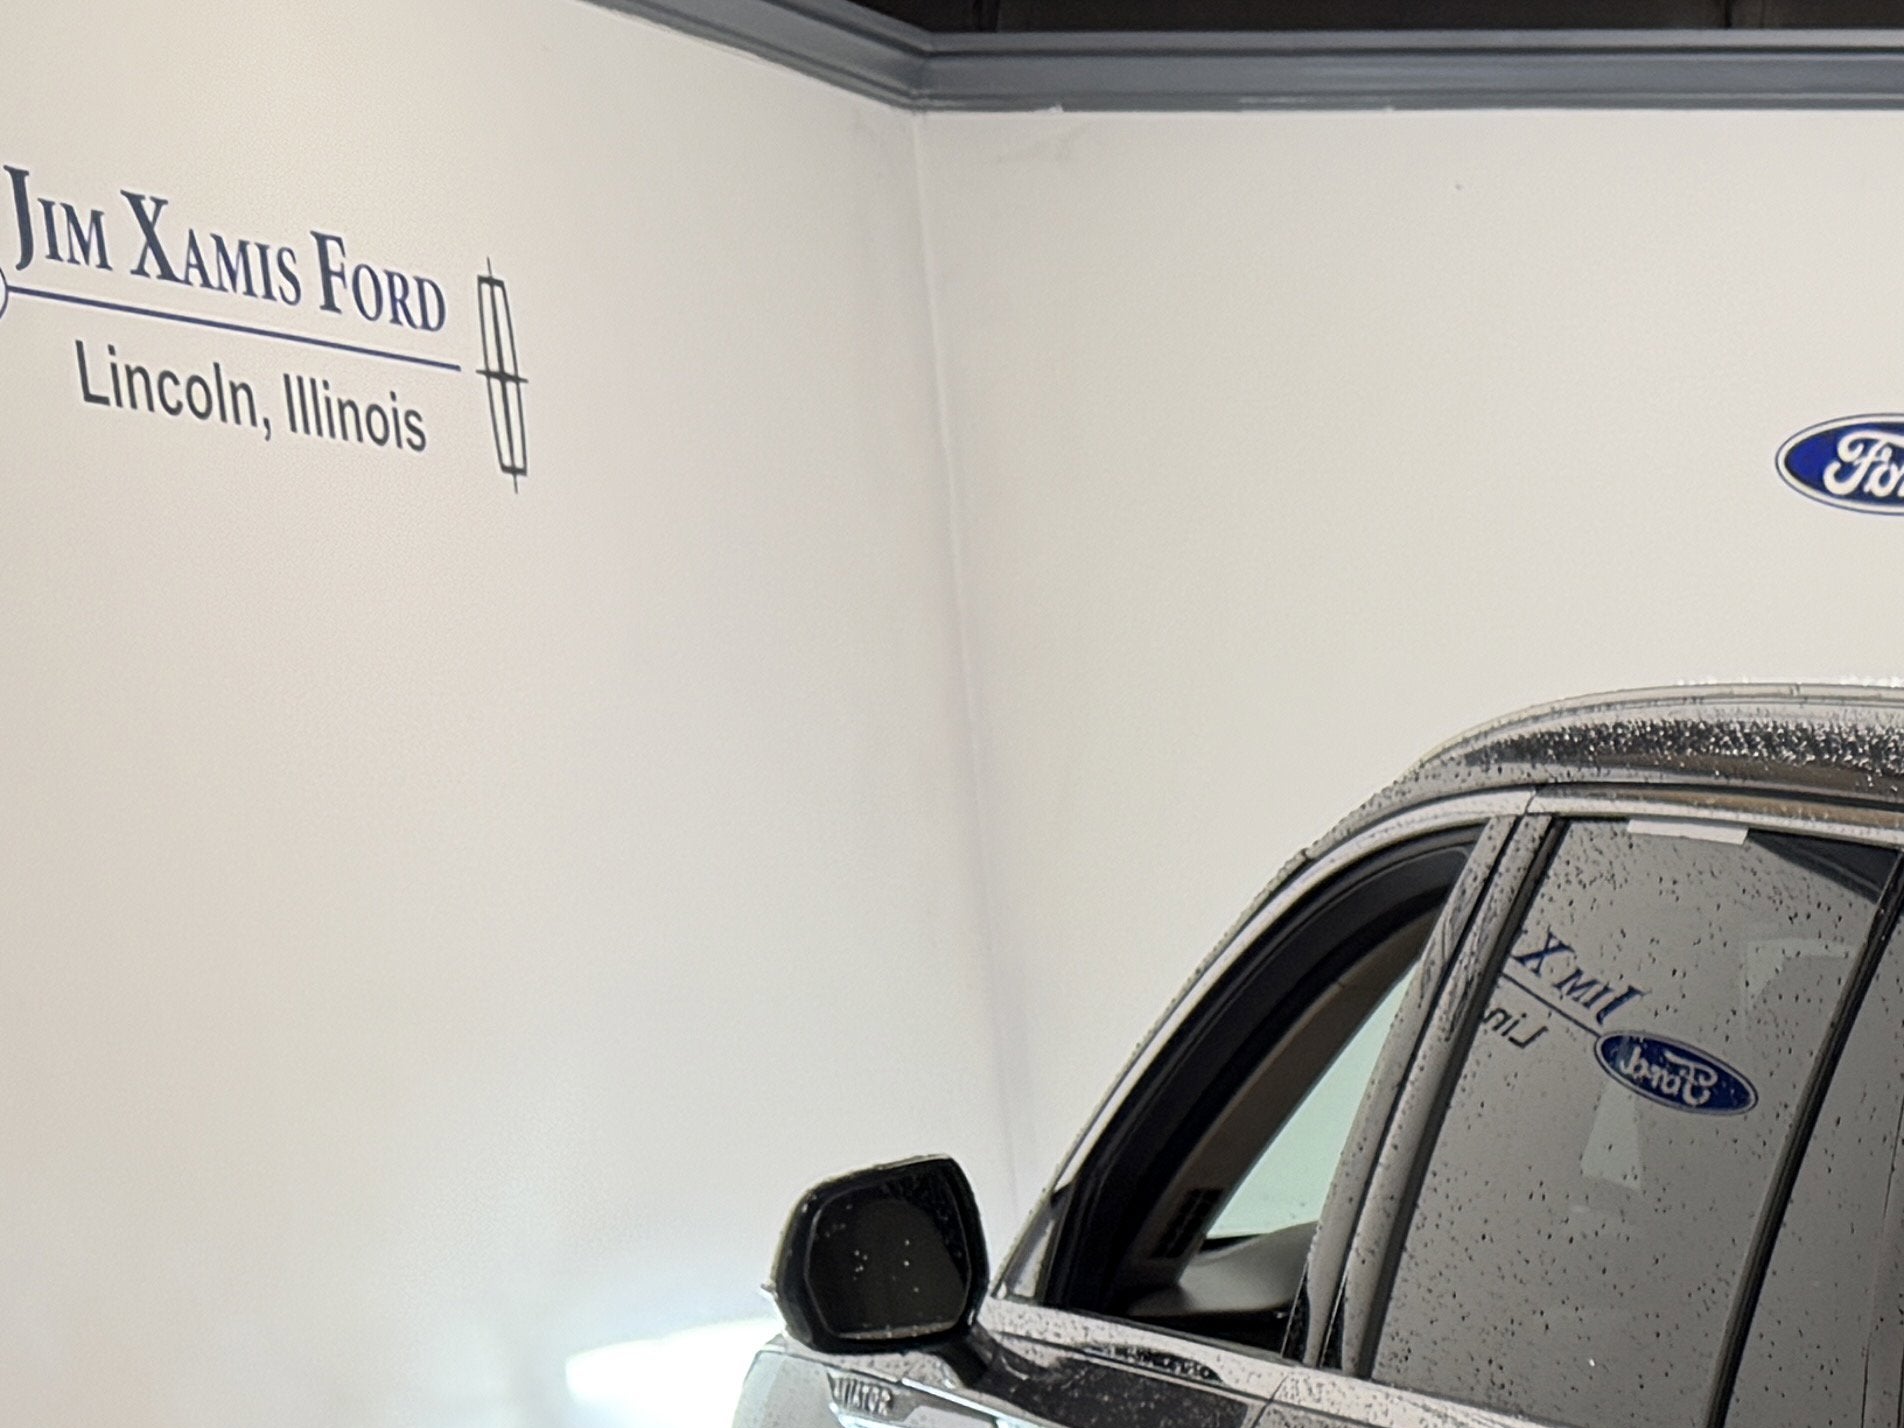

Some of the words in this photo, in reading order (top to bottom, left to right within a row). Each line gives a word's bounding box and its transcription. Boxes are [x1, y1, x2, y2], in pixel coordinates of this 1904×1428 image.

[3, 164, 113, 271] JIM
[120, 190, 302, 306] XAMIS
[310, 231, 447, 332] FORD
[75, 339, 271, 441] Lincoln,
[283, 373, 427, 452] Illinois
